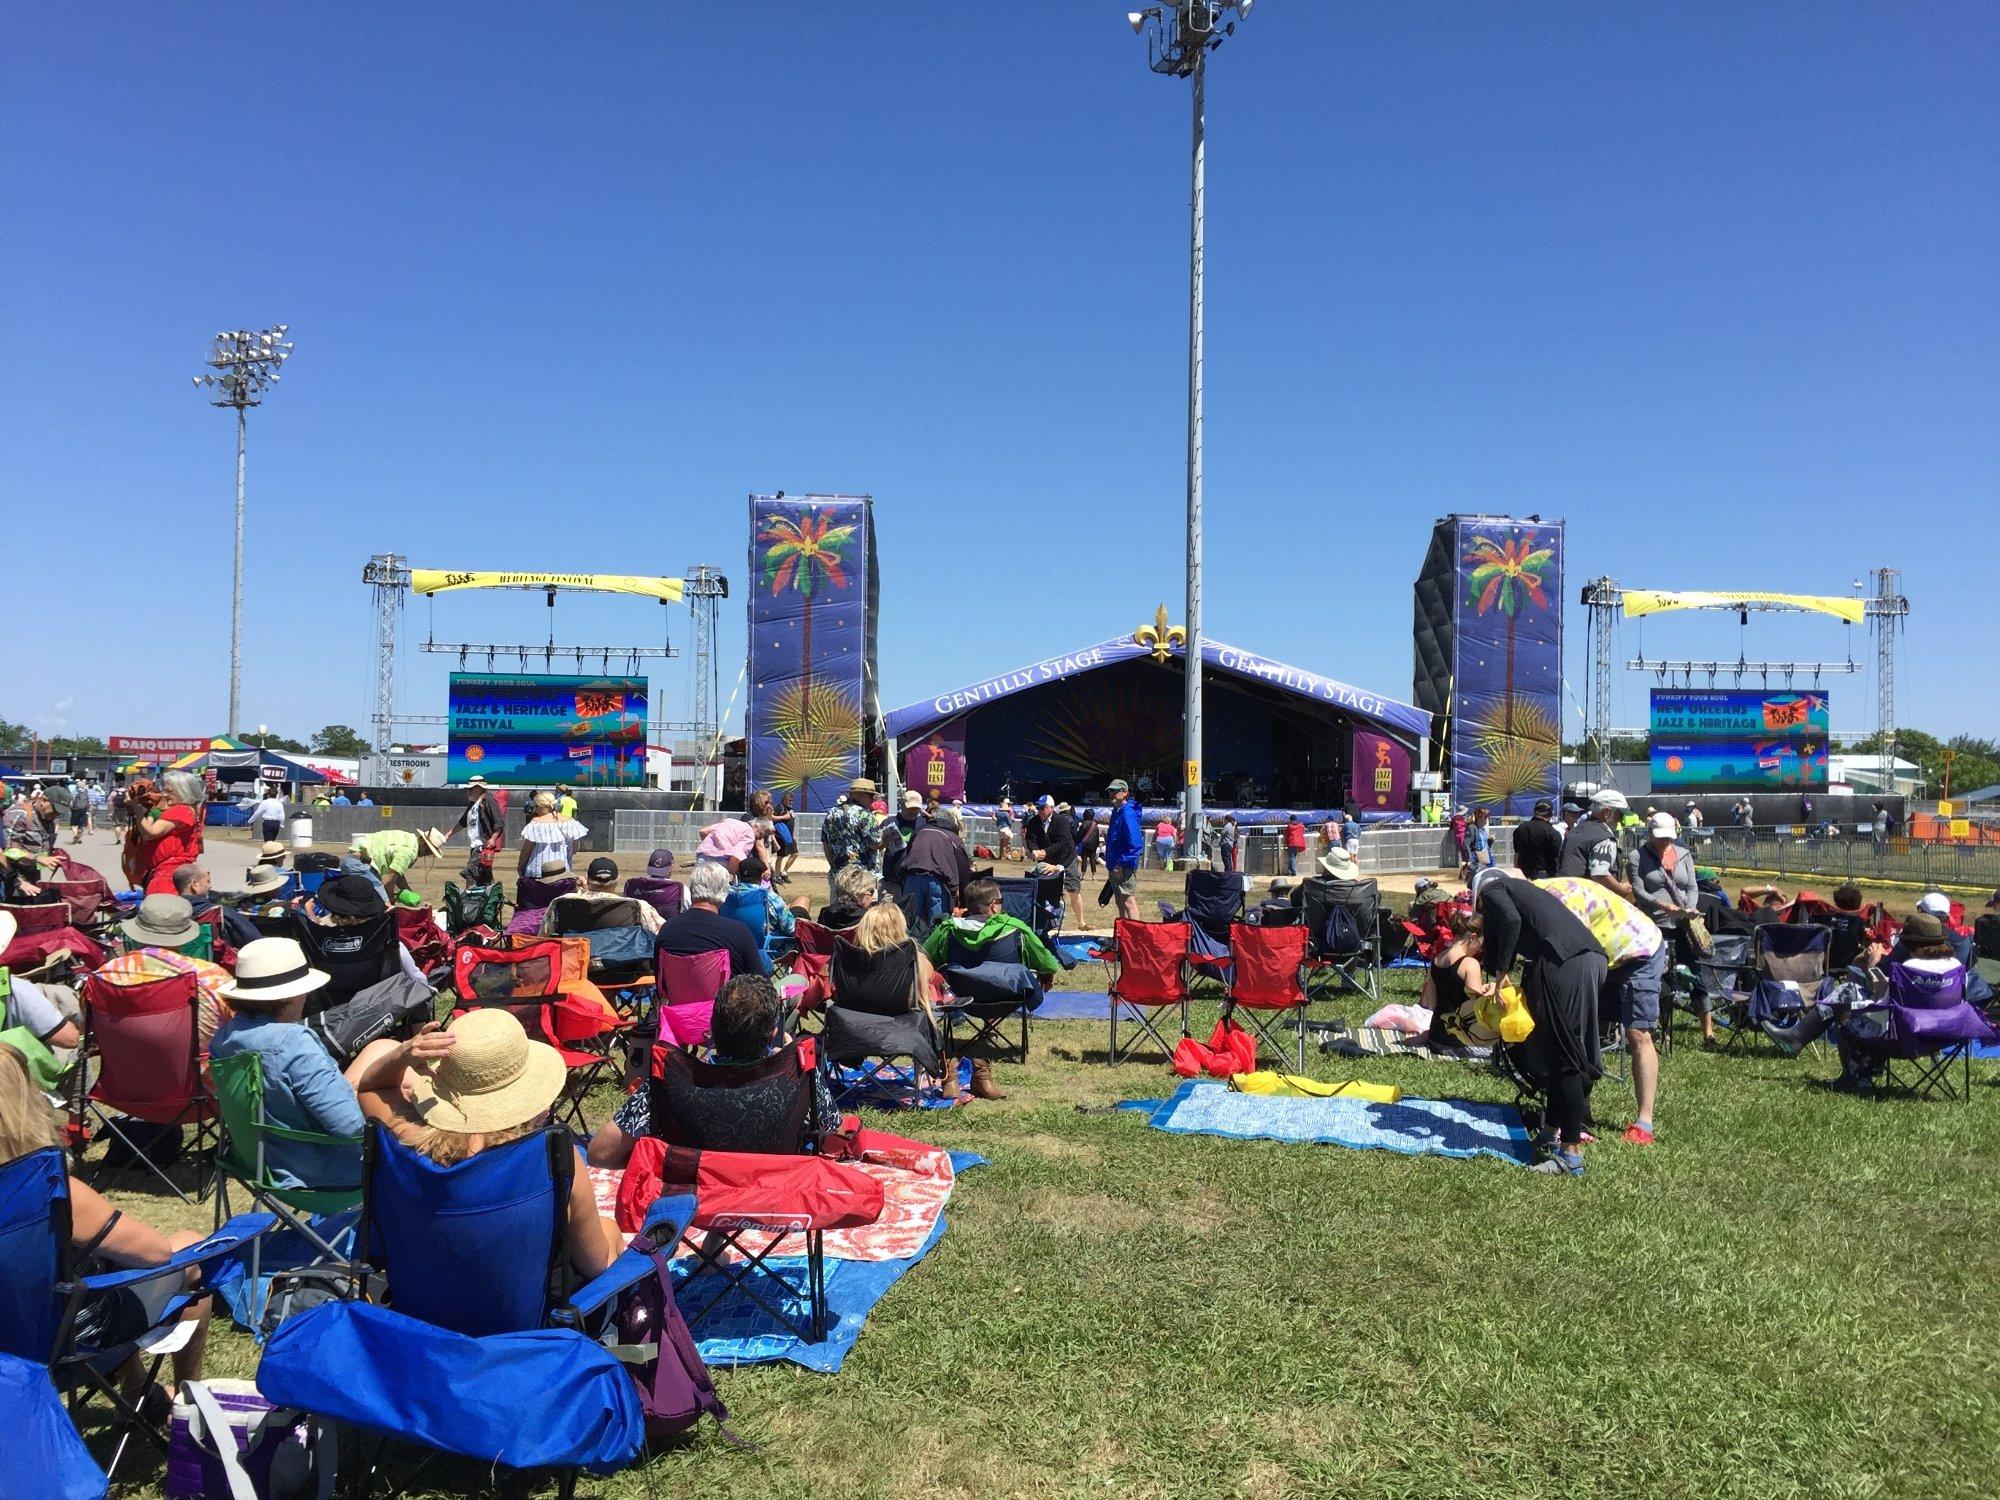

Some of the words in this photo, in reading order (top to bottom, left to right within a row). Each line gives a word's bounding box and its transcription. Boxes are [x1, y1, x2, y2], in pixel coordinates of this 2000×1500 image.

[935, 669, 1035, 714] GENTILLY
[1039, 648, 1104, 679] STAGE
[1218, 649, 1320, 694] GENTILLY
[1323, 682, 1386, 717] STAGE
[456, 703, 487, 714] JAZZ
[490, 704, 501, 715] &
[503, 705, 568, 717] HERITAGE
[1656, 704, 1684, 714] NEW
[456, 717, 515, 730] FESTIVAL
[1656, 716, 1685, 728] JAZZ
[1687, 717, 1697, 729] &
[1698, 717, 1757, 729] HERITAGE
[119, 740, 202, 751] DAIQUIRIS
[929, 763, 944, 773] JAZZ
[929, 774, 944, 783] FEST
[1376, 769, 1391, 780] JAZZ
[1376, 780, 1391, 790] FEST
